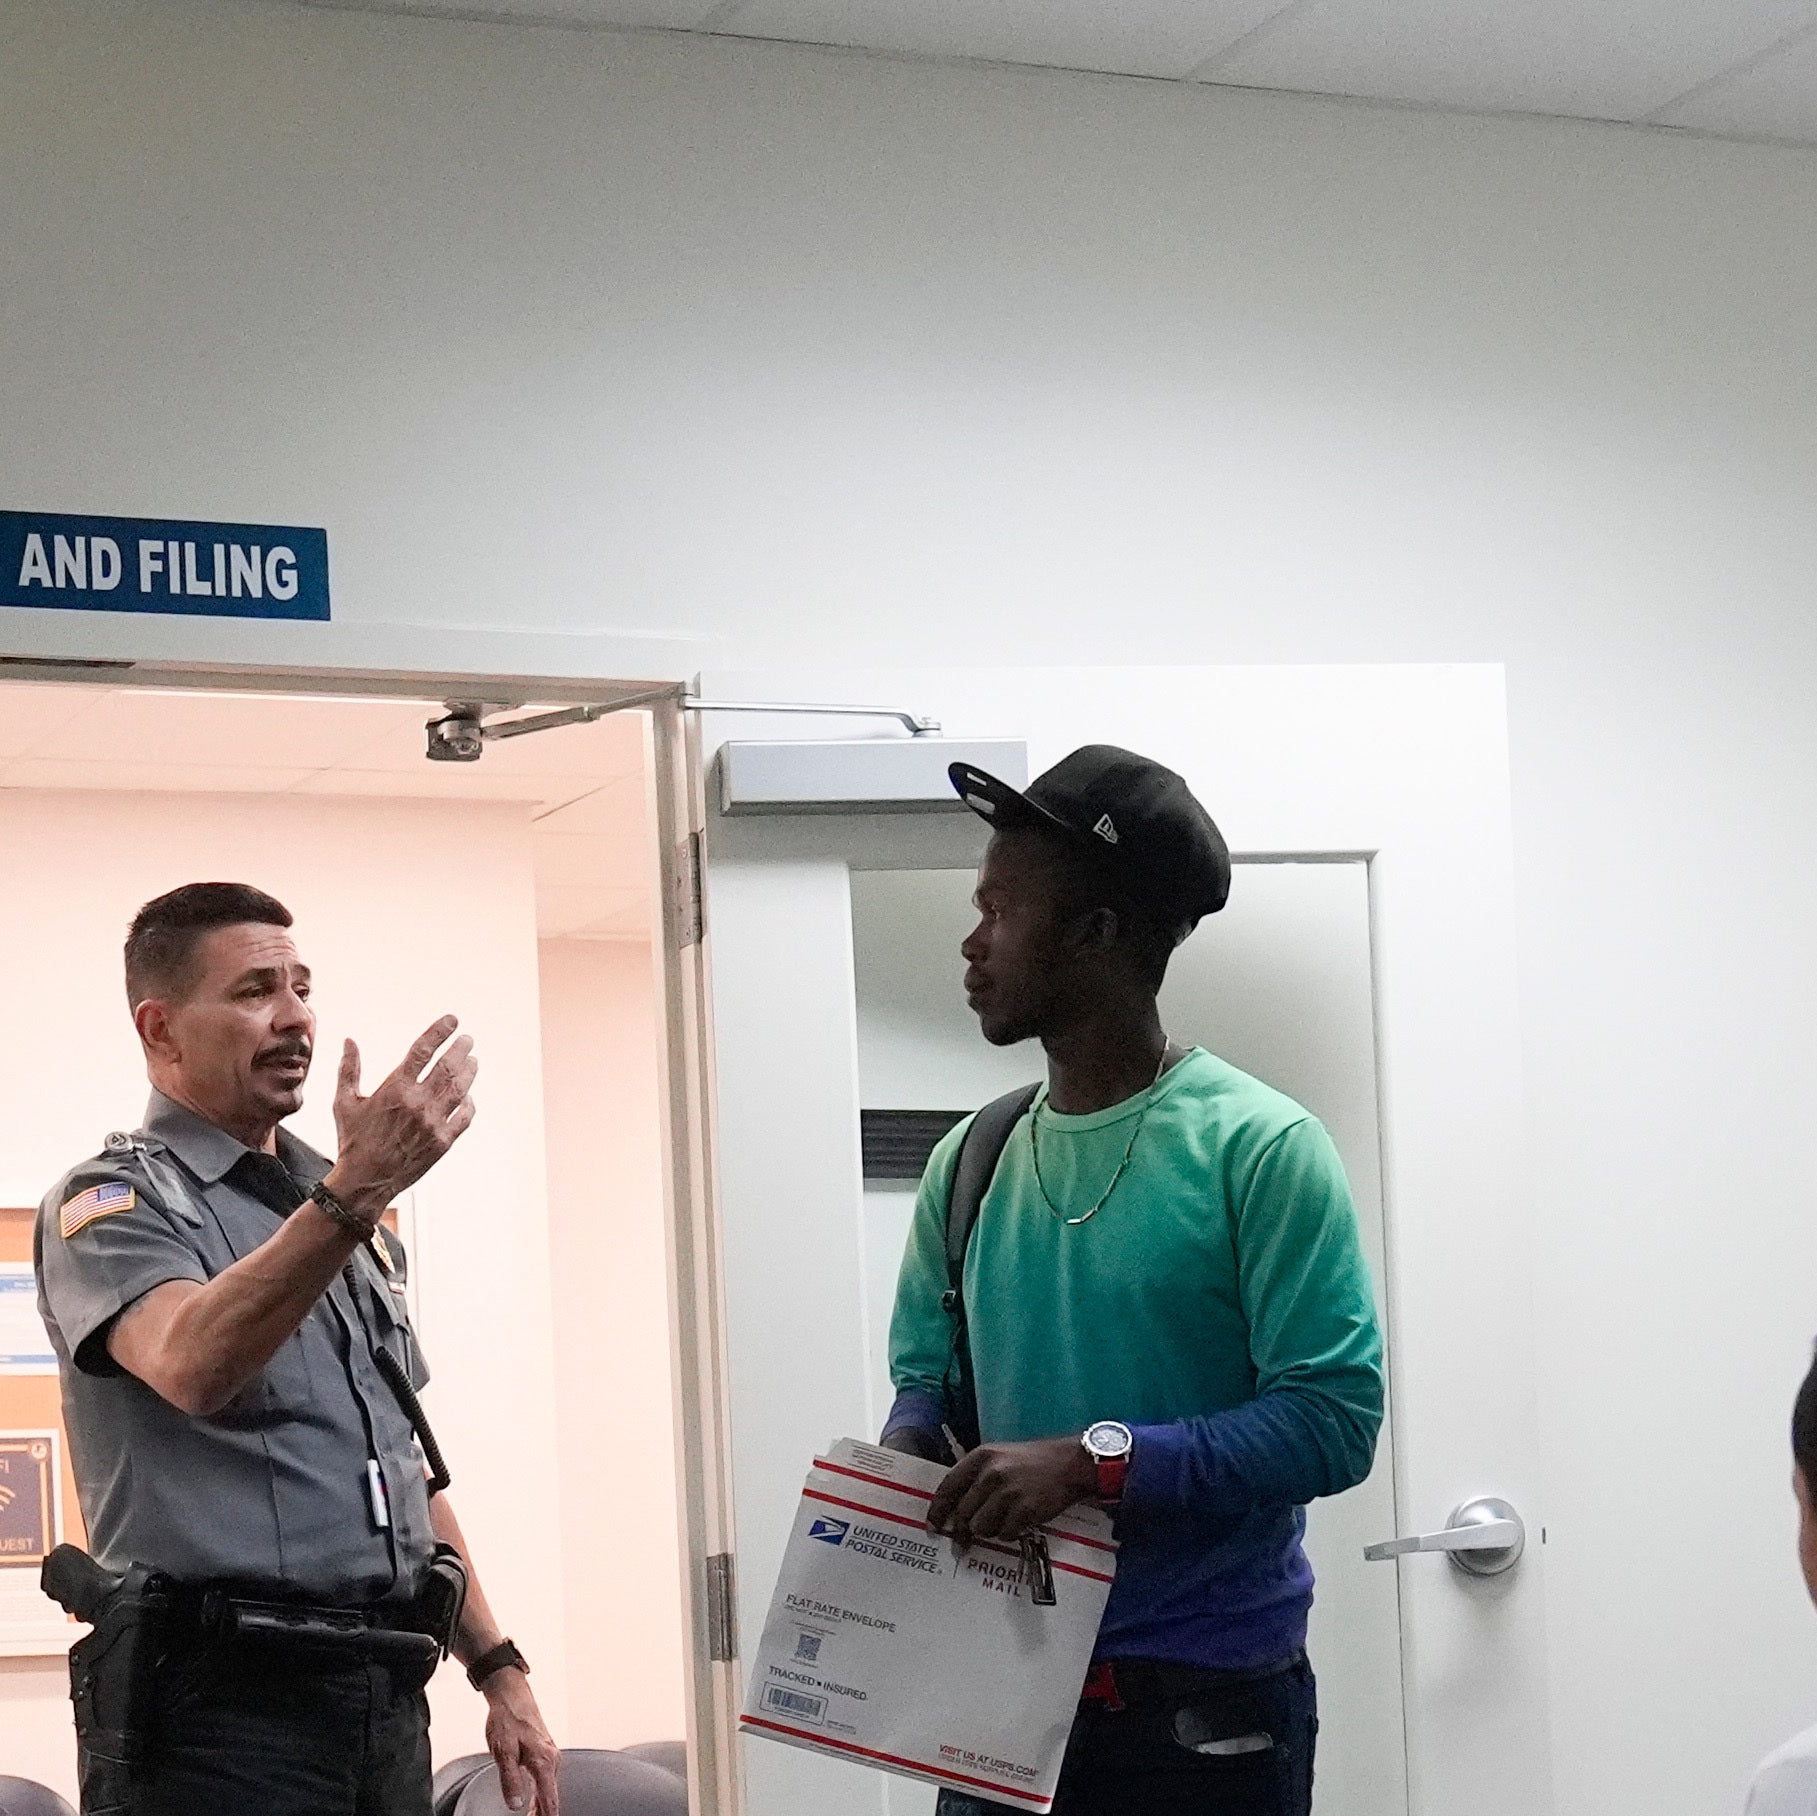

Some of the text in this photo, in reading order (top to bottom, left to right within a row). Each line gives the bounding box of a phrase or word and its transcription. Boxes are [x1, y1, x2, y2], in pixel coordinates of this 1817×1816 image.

[18, 533, 122, 591] AND
[138, 539, 298, 601] FILING
[845, 1538, 888, 1560] POSTAL
[853, 1526, 939, 1558] UNITED STATES
[968, 1558, 1033, 1587] PRIORI
[983, 1577, 1021, 1598] MAIL
[786, 1594, 813, 1609] FLAT
[813, 1601, 842, 1618] RATE
[842, 1609, 897, 1633] ENVELOPE
[768, 1665, 867, 1701] TRACKED INSURED
[940, 1744, 962, 1758] VISIT
[963, 1750, 976, 1761] US
[977, 1753, 990, 1764] AT
